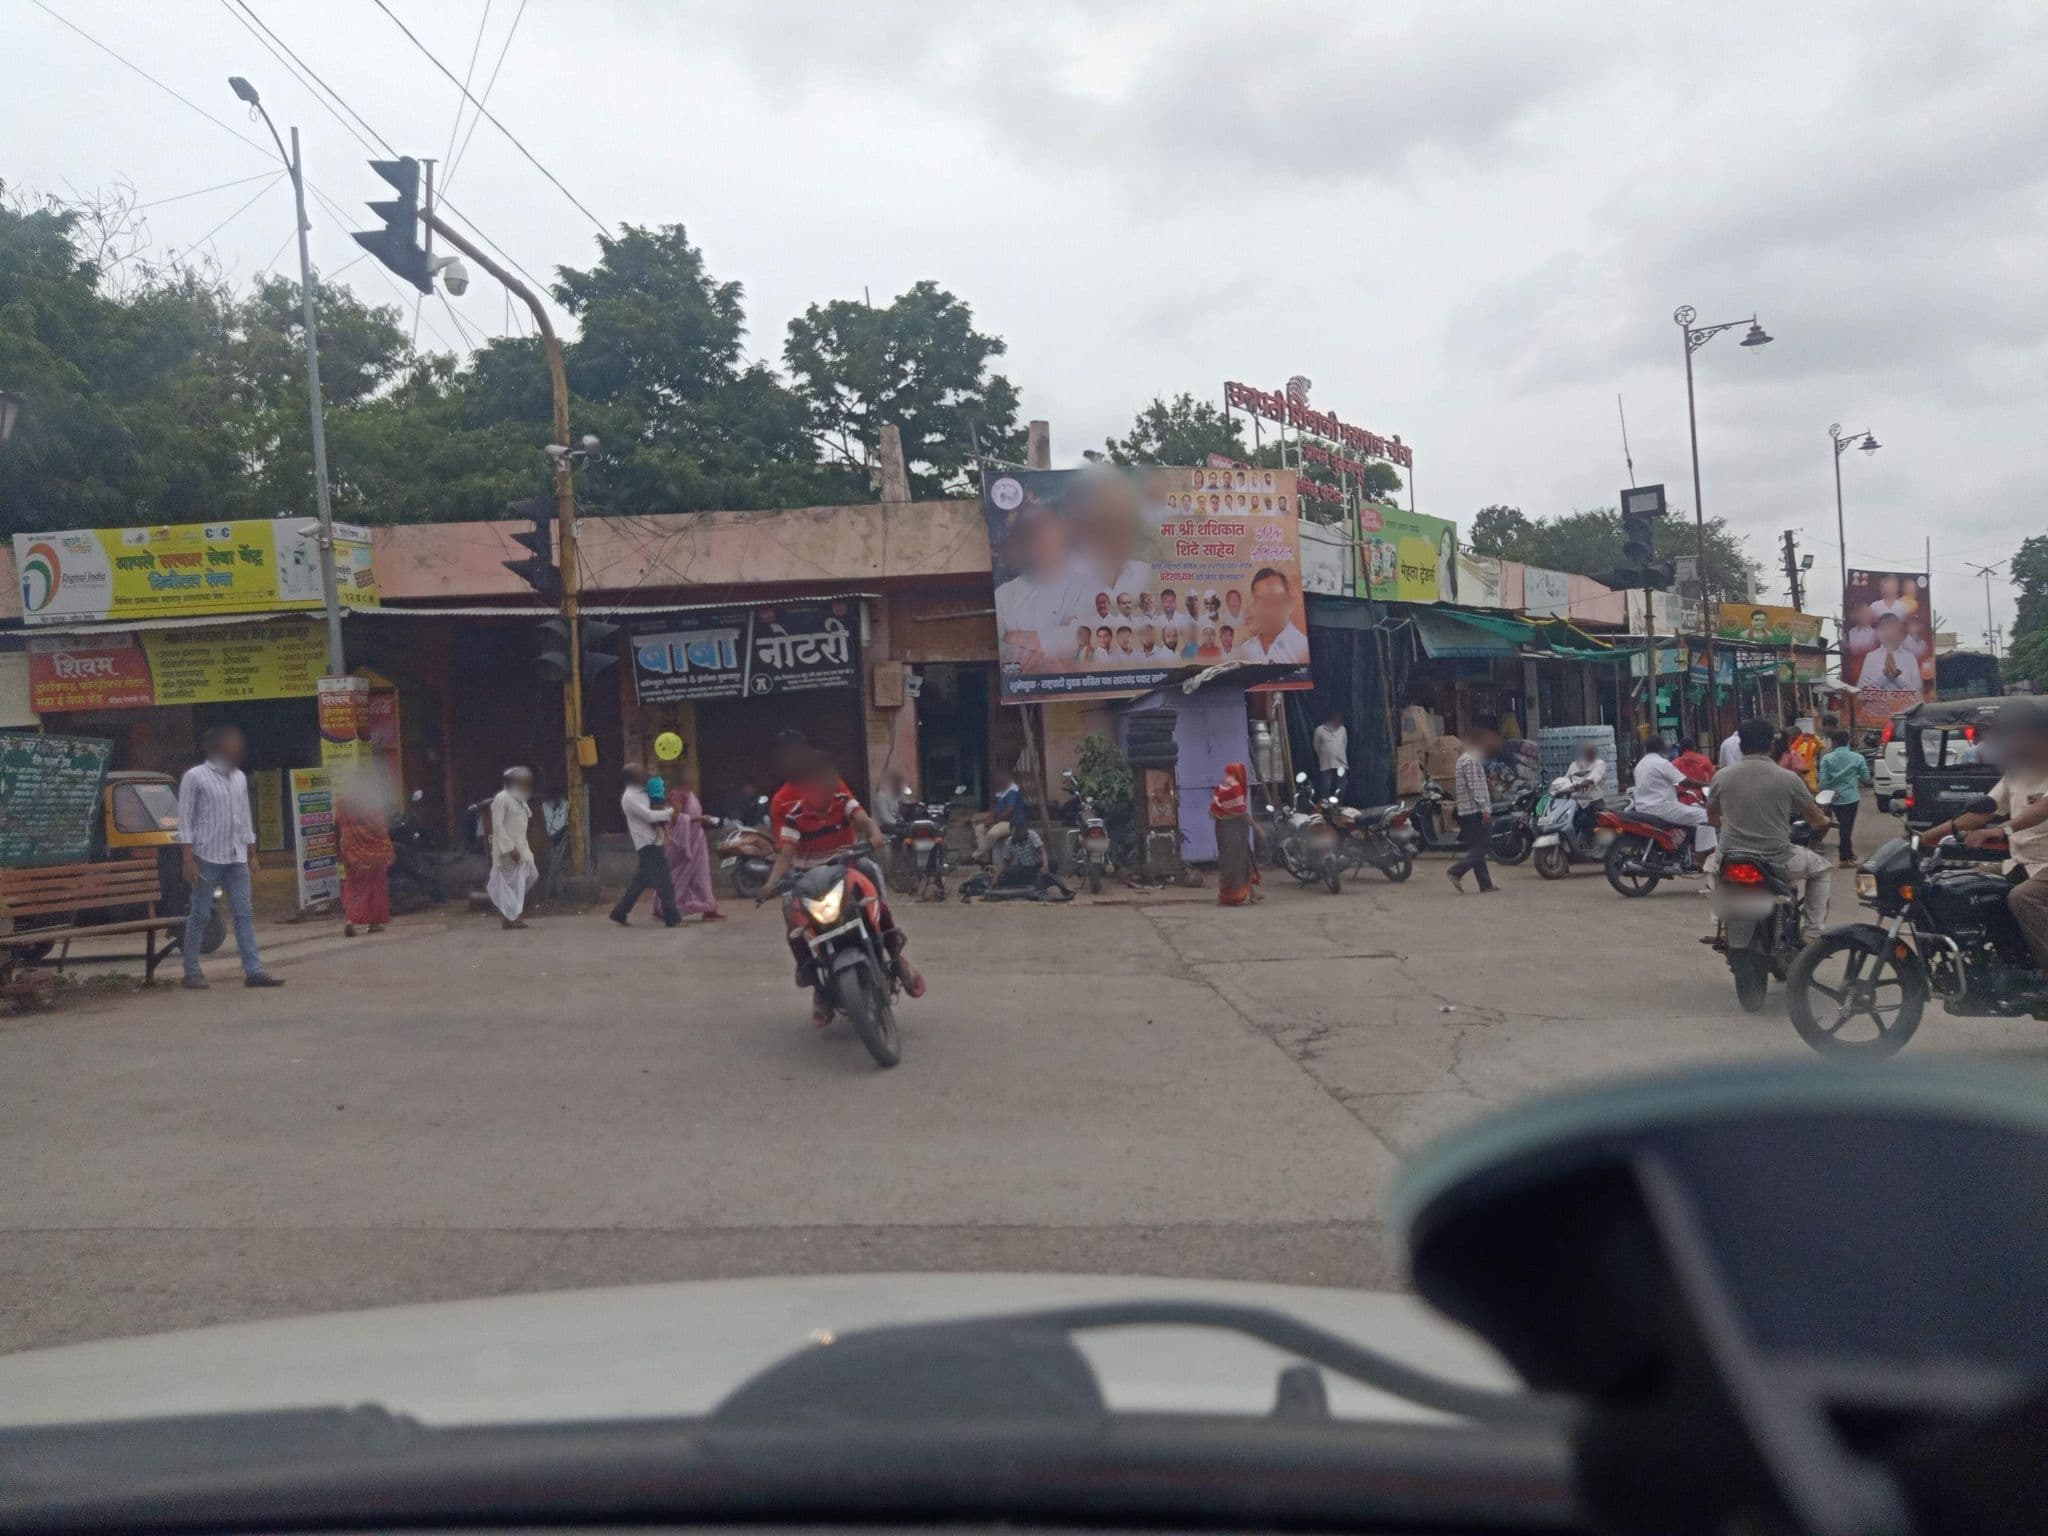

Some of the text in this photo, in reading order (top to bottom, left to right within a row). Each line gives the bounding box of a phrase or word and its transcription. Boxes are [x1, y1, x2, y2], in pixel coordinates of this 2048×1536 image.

[1340, 422, 1384, 459] महाराज
[1385, 434, 1413, 468] चौक
[1160, 520, 1245, 536] मा श्री शशिकांत
[1176, 540, 1200, 557] शिंदे
[63, 572, 106, 584] Digital India
[1400, 560, 1418, 583] मेहता
[633, 628, 740, 674] बाबा
[756, 617, 850, 669] नोटरी
[52, 653, 120, 678] शिवम
